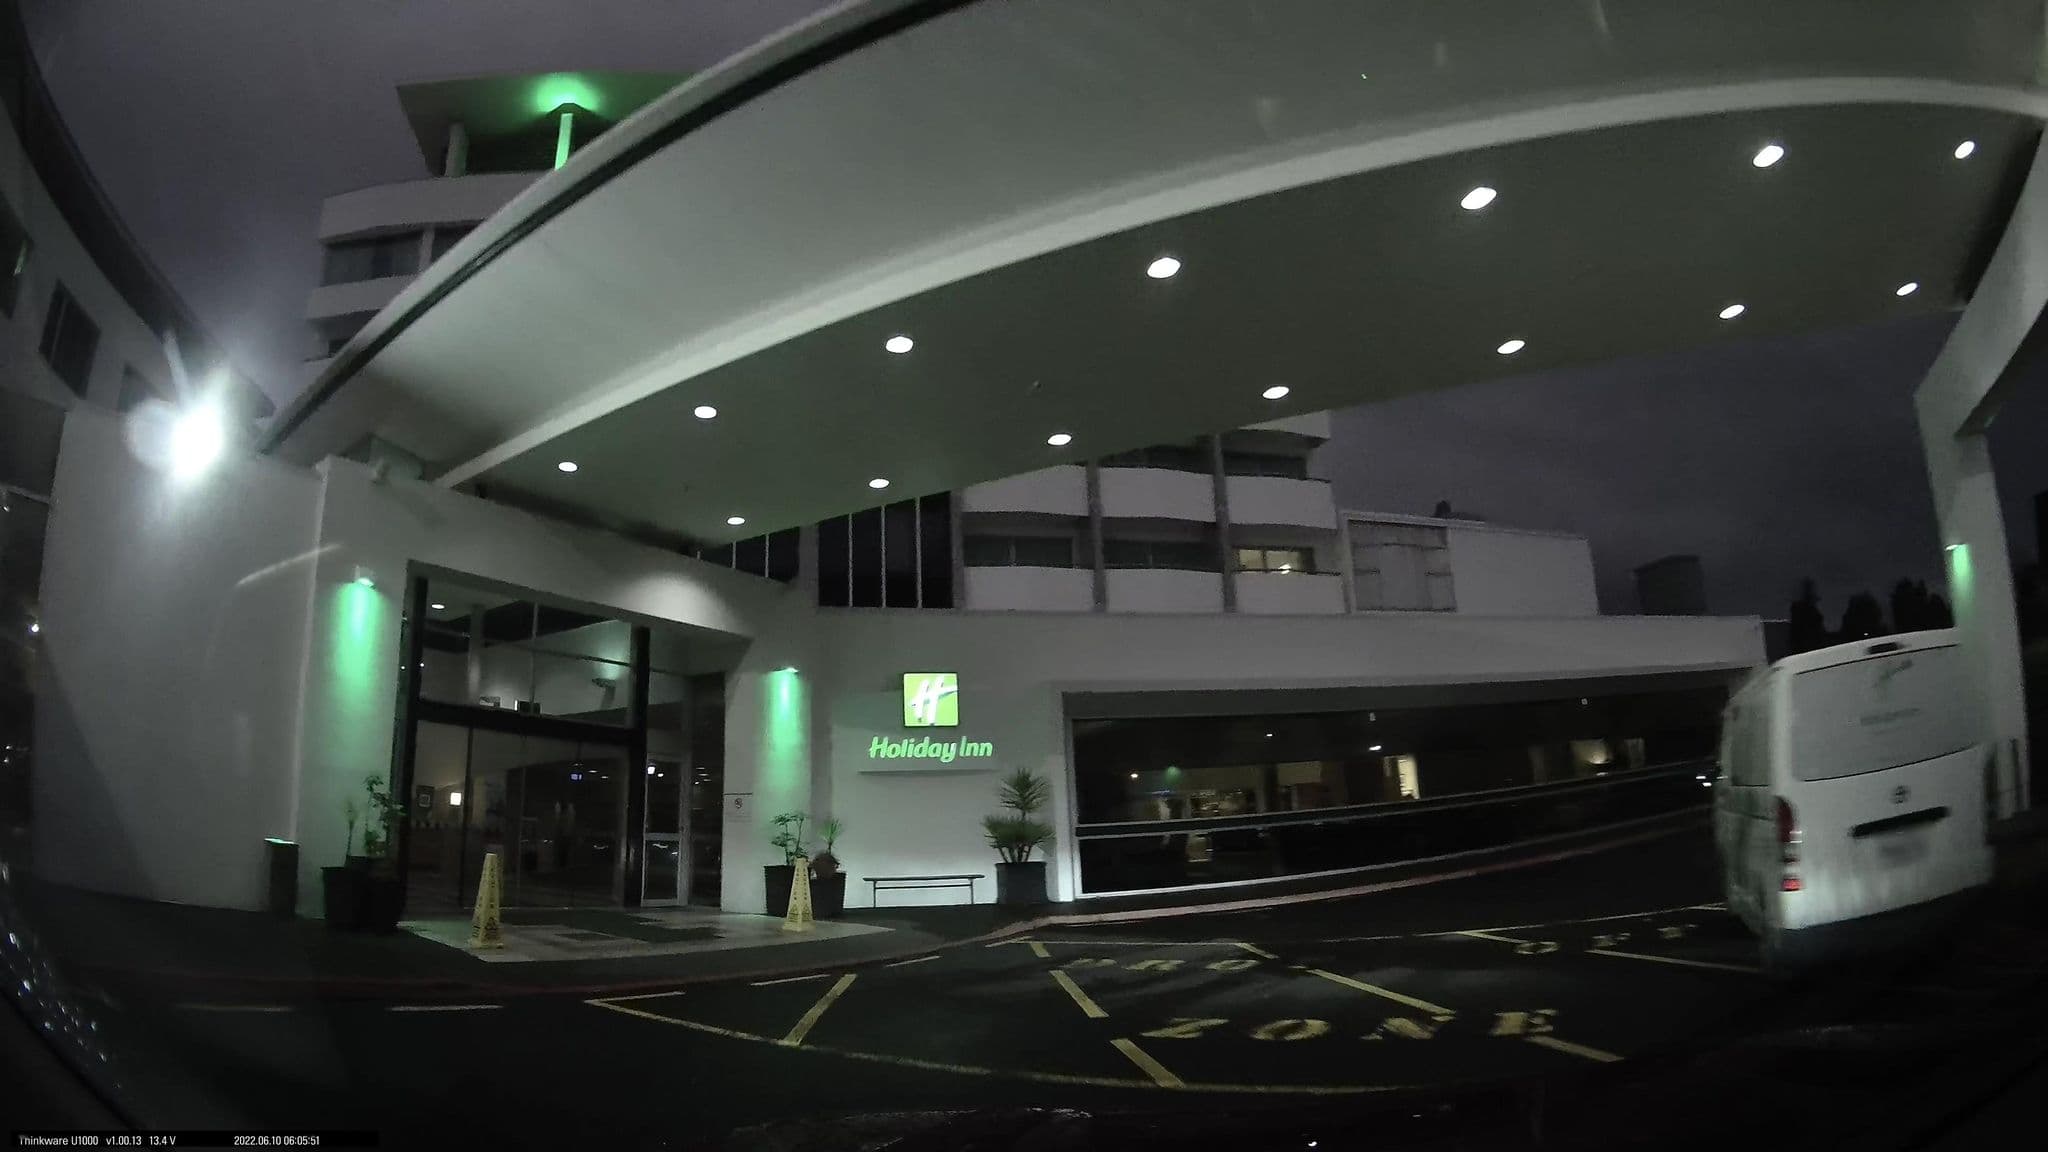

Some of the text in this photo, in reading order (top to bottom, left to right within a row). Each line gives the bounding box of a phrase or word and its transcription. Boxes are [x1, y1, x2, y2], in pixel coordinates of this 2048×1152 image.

[869, 736, 993, 762] Holiday Inn
[1139, 1008, 1559, 1040] ZONE
